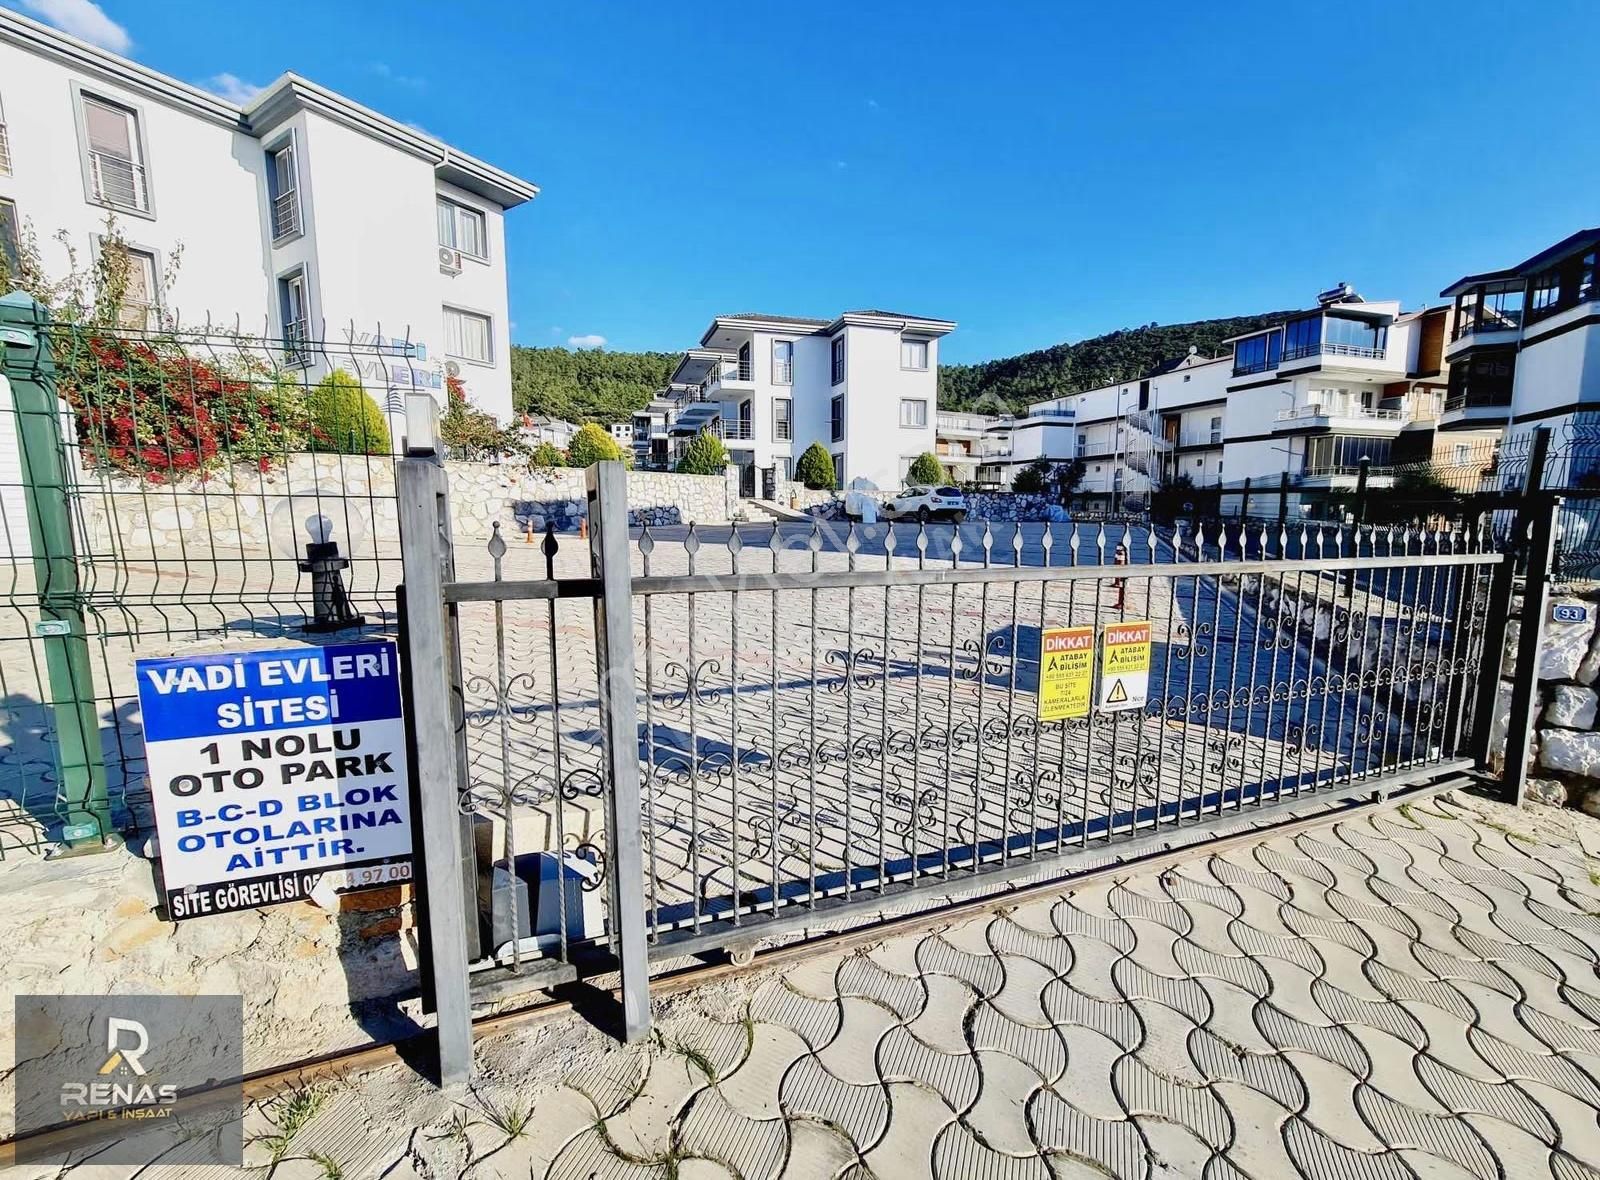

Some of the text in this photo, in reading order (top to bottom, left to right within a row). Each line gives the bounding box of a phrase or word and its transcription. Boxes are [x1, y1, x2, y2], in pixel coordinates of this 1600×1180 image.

[1561, 608, 1578, 620] 93
[1046, 636, 1091, 651] DİKKAT
[1108, 630, 1148, 643] DİKKAT
[1120, 646, 1145, 654] ATABAY
[146, 647, 390, 695] VADİ EVLERİ
[1060, 653, 1088, 661] ATABAY
[217, 689, 340, 728] SİTESİ
[200, 728, 360, 765] 1 NOLU
[169, 752, 395, 797] OTO PARK
[176, 784, 399, 828] B-C-D BLOK
[177, 808, 403, 853] OTOLARINA
[225, 838, 365, 872] AİTTİR.
[215, 873, 300, 910] GÖREVLİSİ
[389, 865, 411, 879] 00
